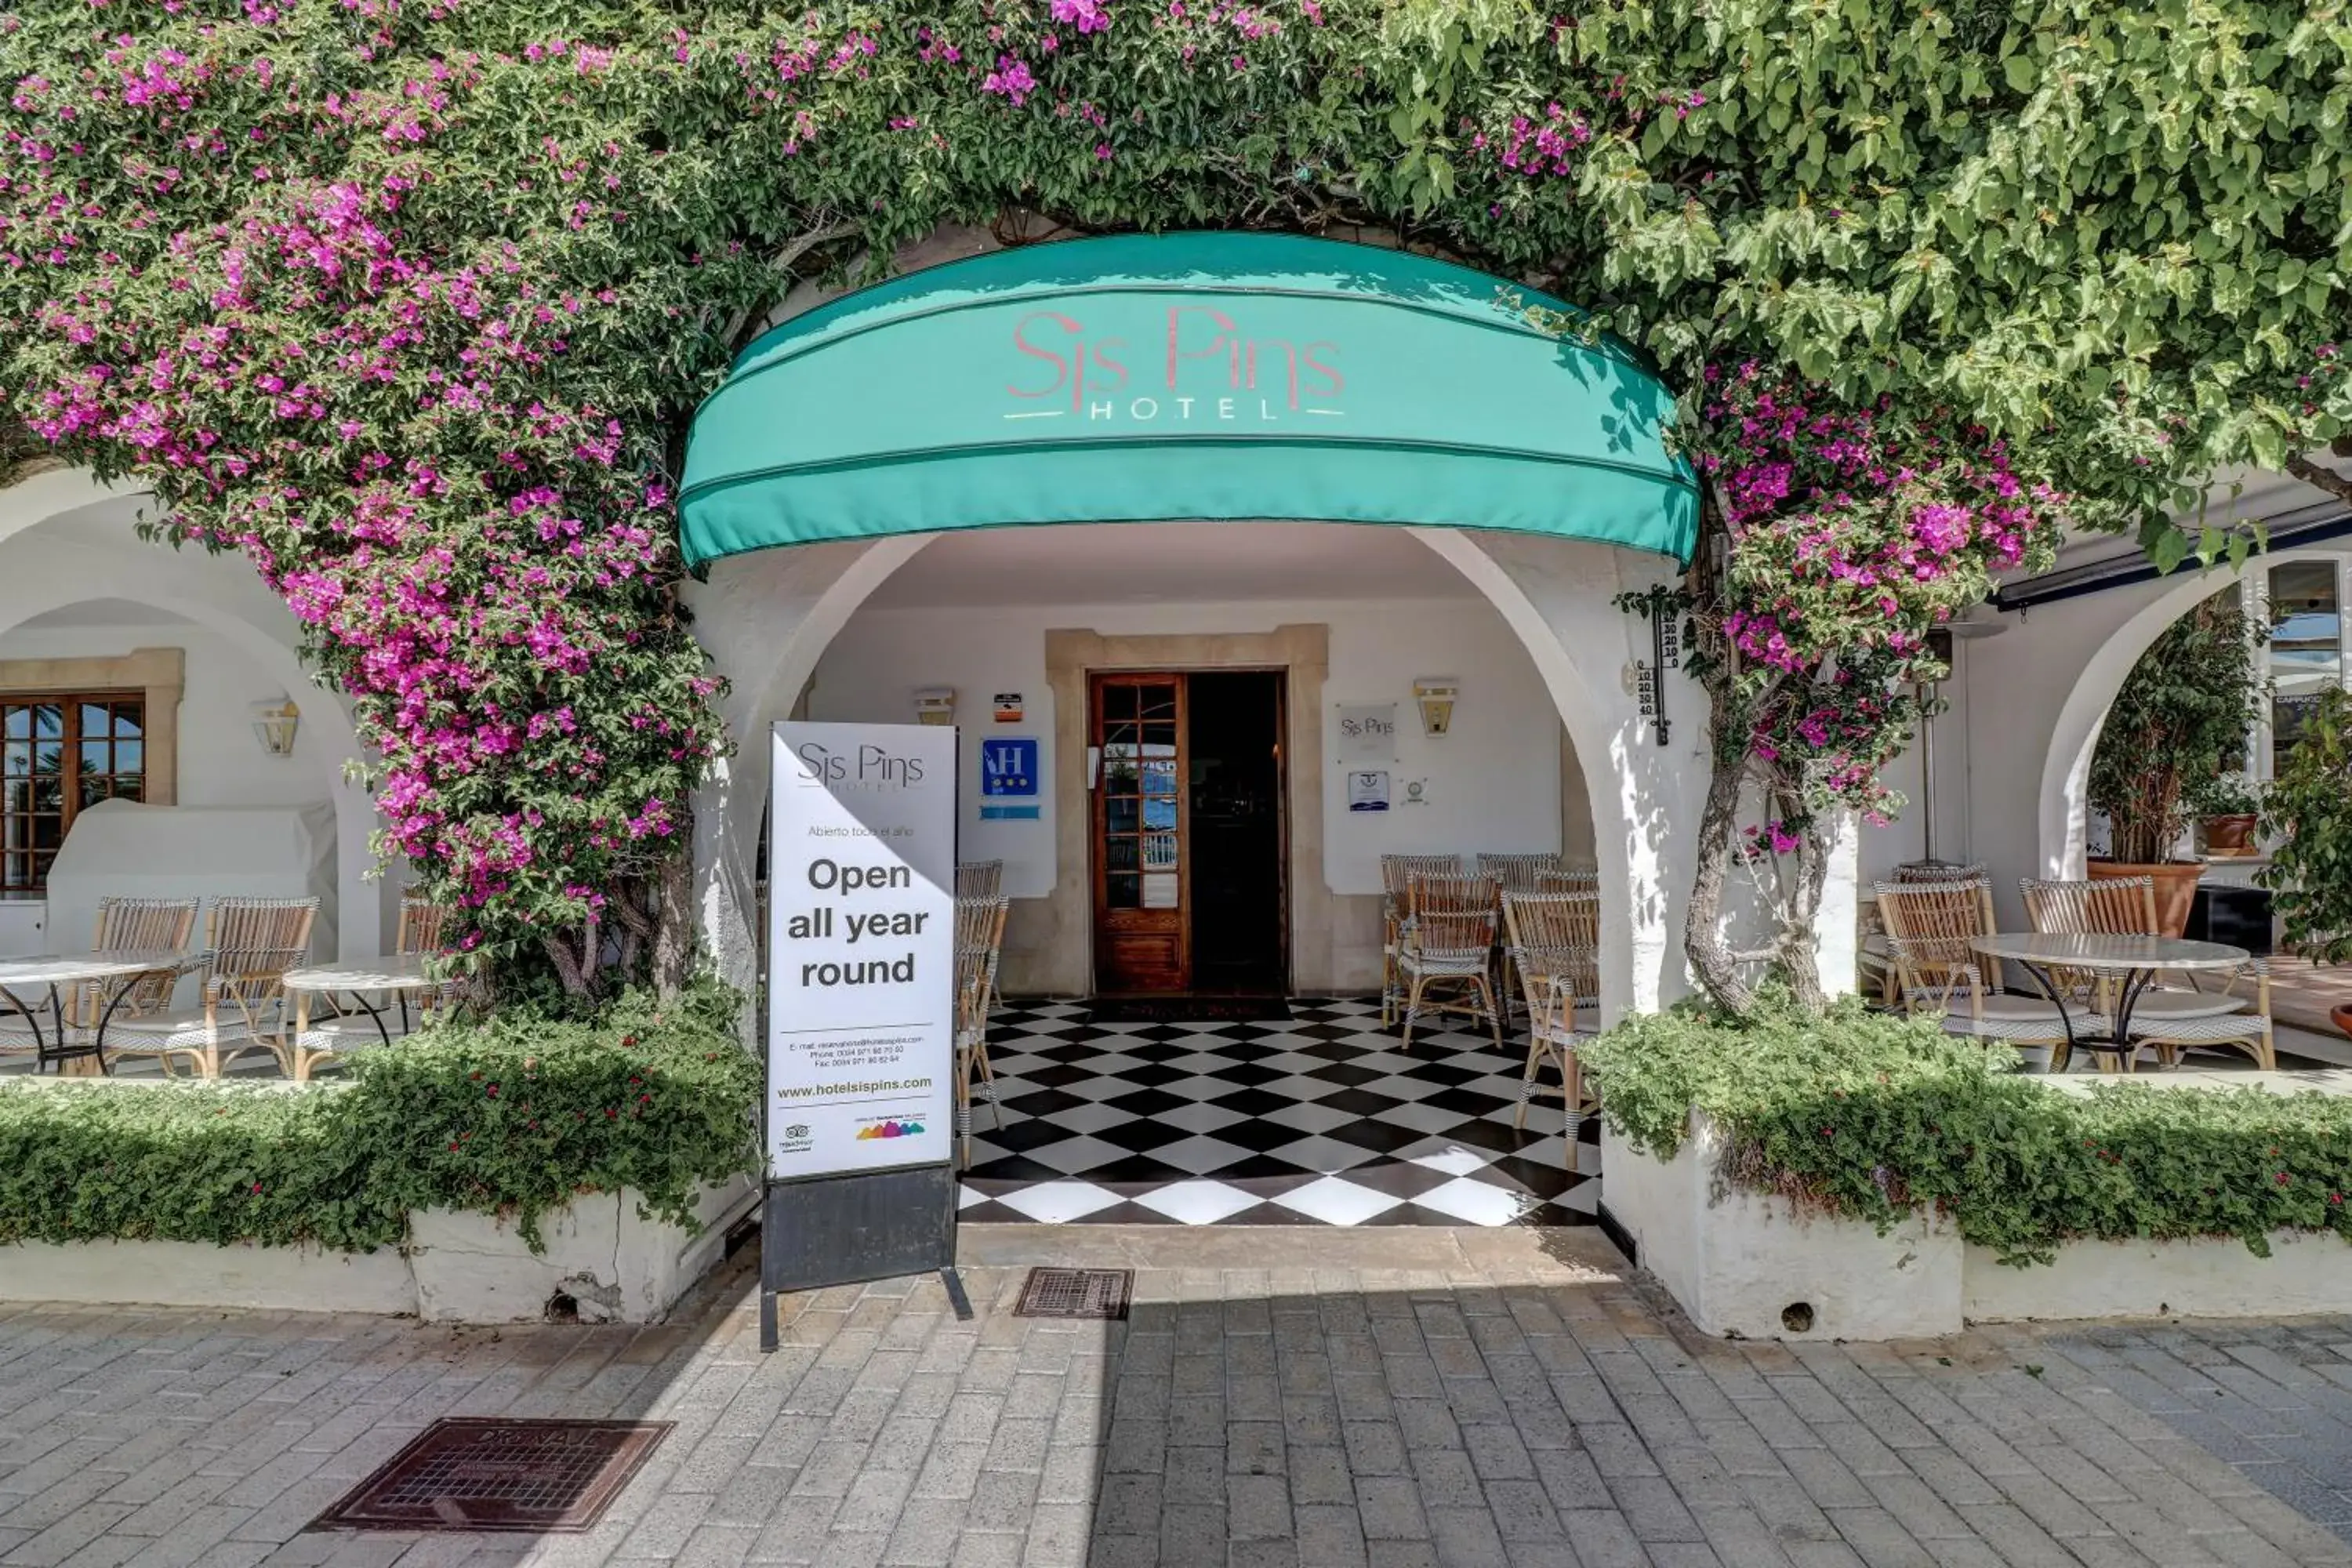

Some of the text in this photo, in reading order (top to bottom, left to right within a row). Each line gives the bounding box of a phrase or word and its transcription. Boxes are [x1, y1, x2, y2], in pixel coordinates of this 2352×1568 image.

[1005, 306, 1346, 413] Sis Pins
[1091, 397, 1278, 420] HOTEL
[797, 742, 923, 787] Sis Pins
[996, 747, 1025, 775] H
[808, 826, 849, 837] Abierto
[808, 858, 910, 896] Open
[788, 908, 929, 943] all year
[802, 953, 915, 987] round
[778, 1077, 932, 1099] www.hotelsispins.com
